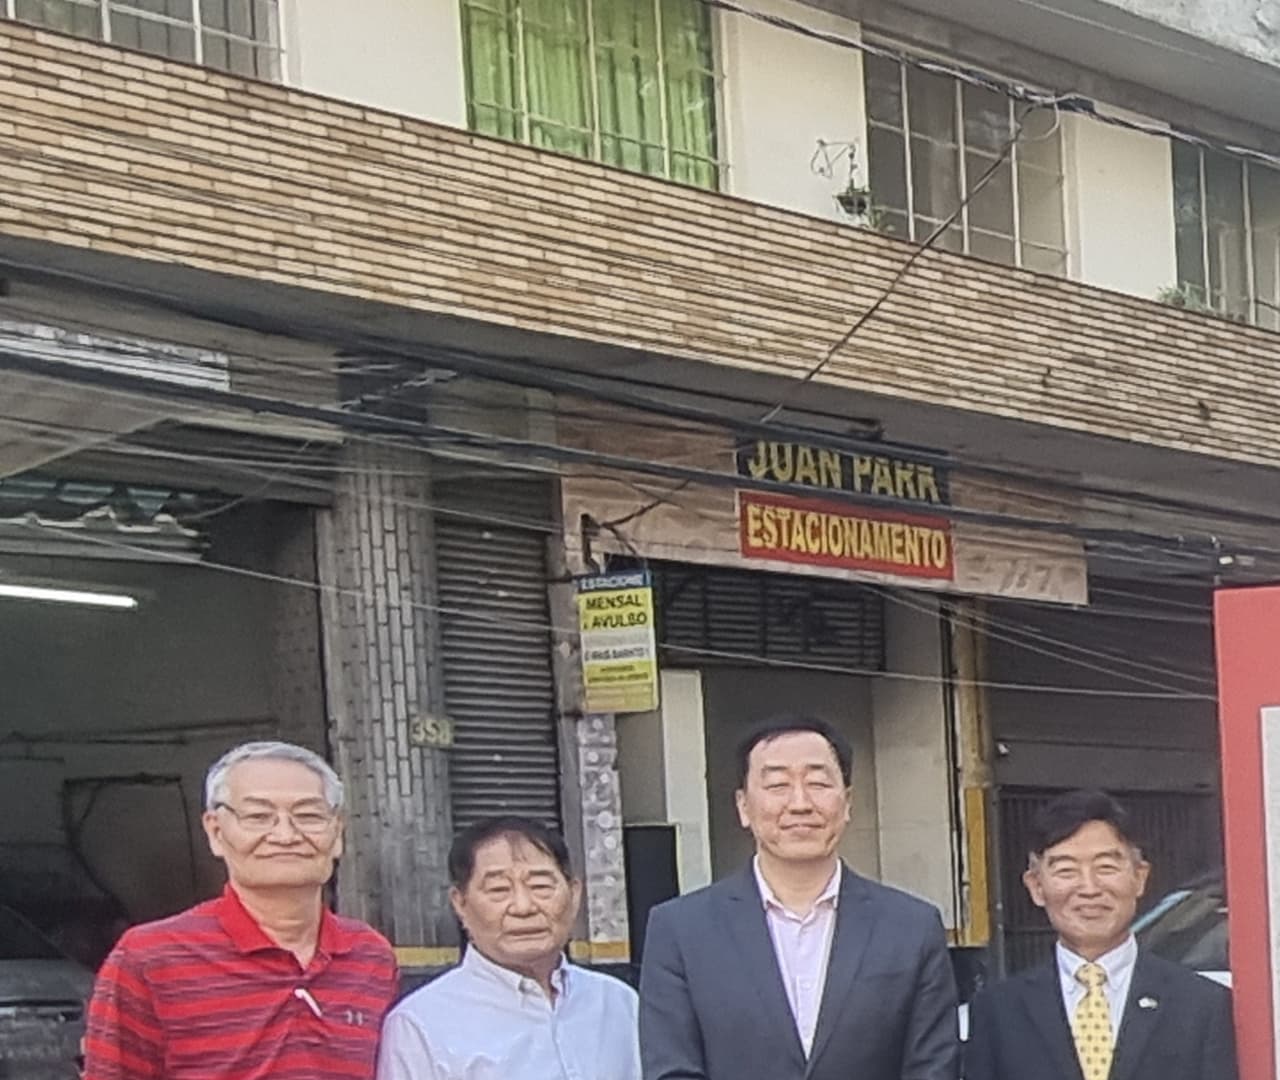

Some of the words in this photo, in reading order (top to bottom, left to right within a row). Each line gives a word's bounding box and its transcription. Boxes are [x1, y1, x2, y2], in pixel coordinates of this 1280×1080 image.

[748, 440, 842, 488] JUAN
[748, 502, 946, 570] ESTACIONAMENTO
[586, 594, 643, 610] MENSAL
